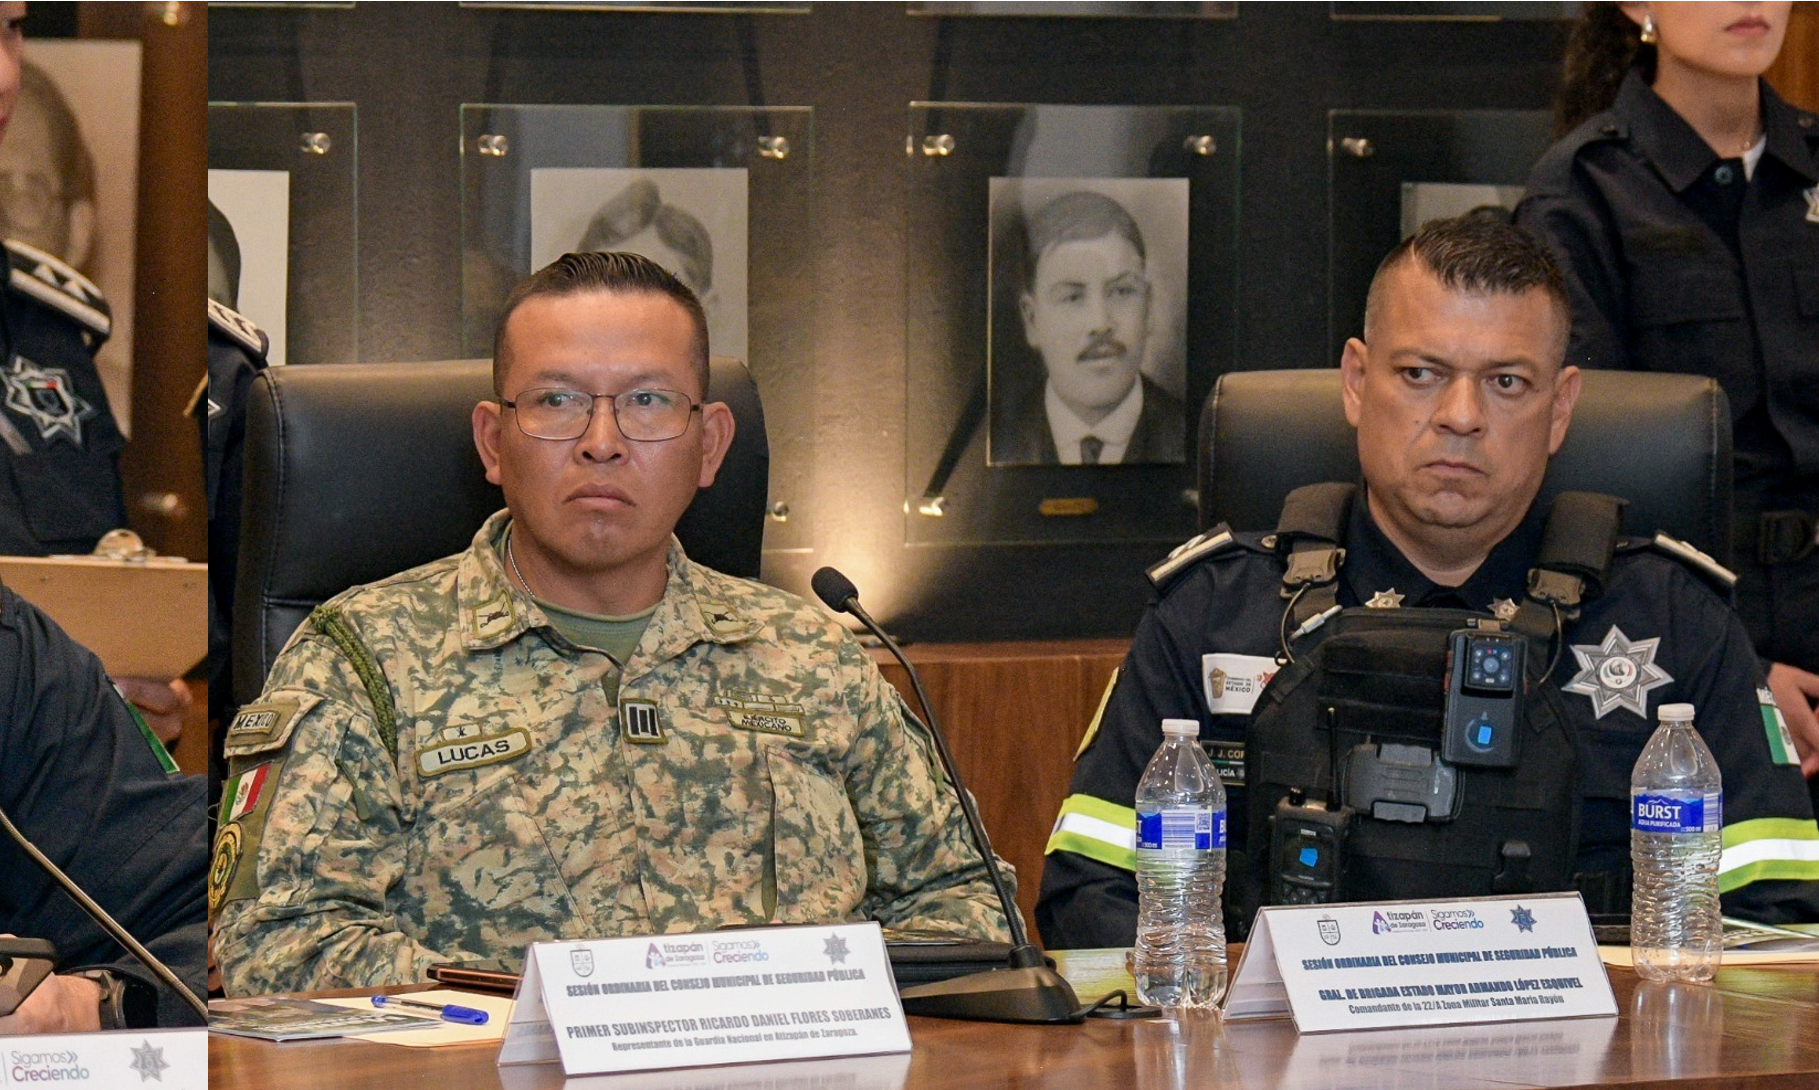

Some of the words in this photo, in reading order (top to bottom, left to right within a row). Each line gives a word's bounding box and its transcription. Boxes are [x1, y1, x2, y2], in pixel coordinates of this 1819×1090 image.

[437, 739, 511, 765] LUCAS
[1638, 803, 1681, 819] BURST
[1431, 909, 1468, 920] Sigamos
[1433, 918, 1484, 931] Creciendo
[713, 950, 769, 964] Creciendo
[1302, 956, 1334, 970] SESIÓN
[1335, 955, 1382, 969] ORDINARIA
[1382, 955, 1397, 966] DEL
[1398, 953, 1435, 966] CONSEJO
[1436, 950, 1482, 964] MUNICIPAL
[1483, 950, 1494, 961] DE
[1494, 947, 1541, 961] SEGURIDAD
[1542, 945, 1577, 959] PÚBLICA
[566, 982, 600, 997] SESIÓN
[601, 981, 652, 995] ORDINARIA
[653, 980, 669, 992] DEL
[671, 977, 710, 991] CONSEJO
[712, 974, 761, 988] MUNICIPAL
[763, 973, 773, 985] DE
[775, 971, 826, 985] SEGURIDAD
[826, 968, 865, 982] PÚBLICA
[1345, 988, 1359, 999] DE
[1359, 986, 1400, 999] BRIGADA
[1401, 984, 1435, 997] ESTADO
[1435, 983, 1468, 996] MAYOR
[1468, 980, 1513, 994] ARMANDO
[1515, 978, 1541, 990] LÓPEZ
[1541, 977, 1583, 990] ESQUIVEL
[1349, 1002, 1401, 1014] Comandante
[1402, 1002, 1412, 1011] de
[1414, 1001, 1422, 1011] la
[1423, 1000, 1441, 1011] 22/A
[1443, 1000, 1462, 1009] Zona
[1463, 997, 1489, 1009] Militar
[1490, 996, 1514, 1007] Santa
[566, 1024, 611, 1039] PRIMER
[612, 1018, 698, 1036] SUBINSPECTOR
[699, 1015, 749, 1030] RICARDO
[750, 1012, 790, 1027] DANIEL
[790, 1010, 830, 1025] FLORES
[831, 1007, 891, 1023] SOBERANES
[612, 1041, 671, 1052] Representante
[673, 1039, 683, 1048] de
[684, 1038, 693, 1047] la
[694, 1035, 725, 1046] Guardia
[727, 1032, 762, 1045] Nacional
[763, 1033, 773, 1041] en
[775, 1030, 808, 1041] Atizapán
[810, 1029, 820, 1038] de
[11, 1050, 68, 1068] Sigamos
[12, 1065, 90, 1082] Creciendo
